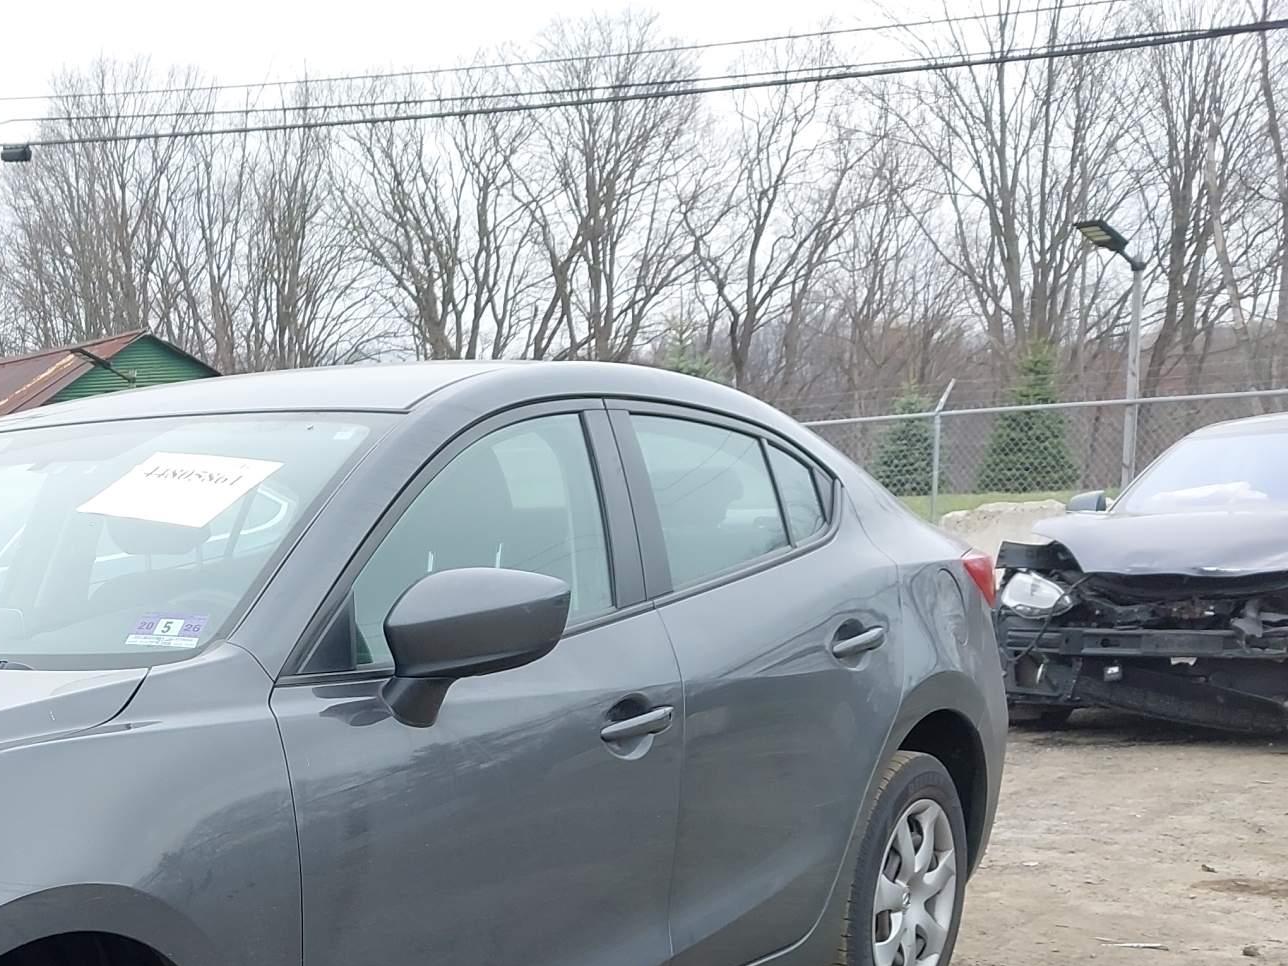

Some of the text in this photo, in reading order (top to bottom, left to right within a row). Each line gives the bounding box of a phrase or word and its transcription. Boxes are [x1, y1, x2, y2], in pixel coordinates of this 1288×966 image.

[136, 620, 201, 634] 20 5 26
